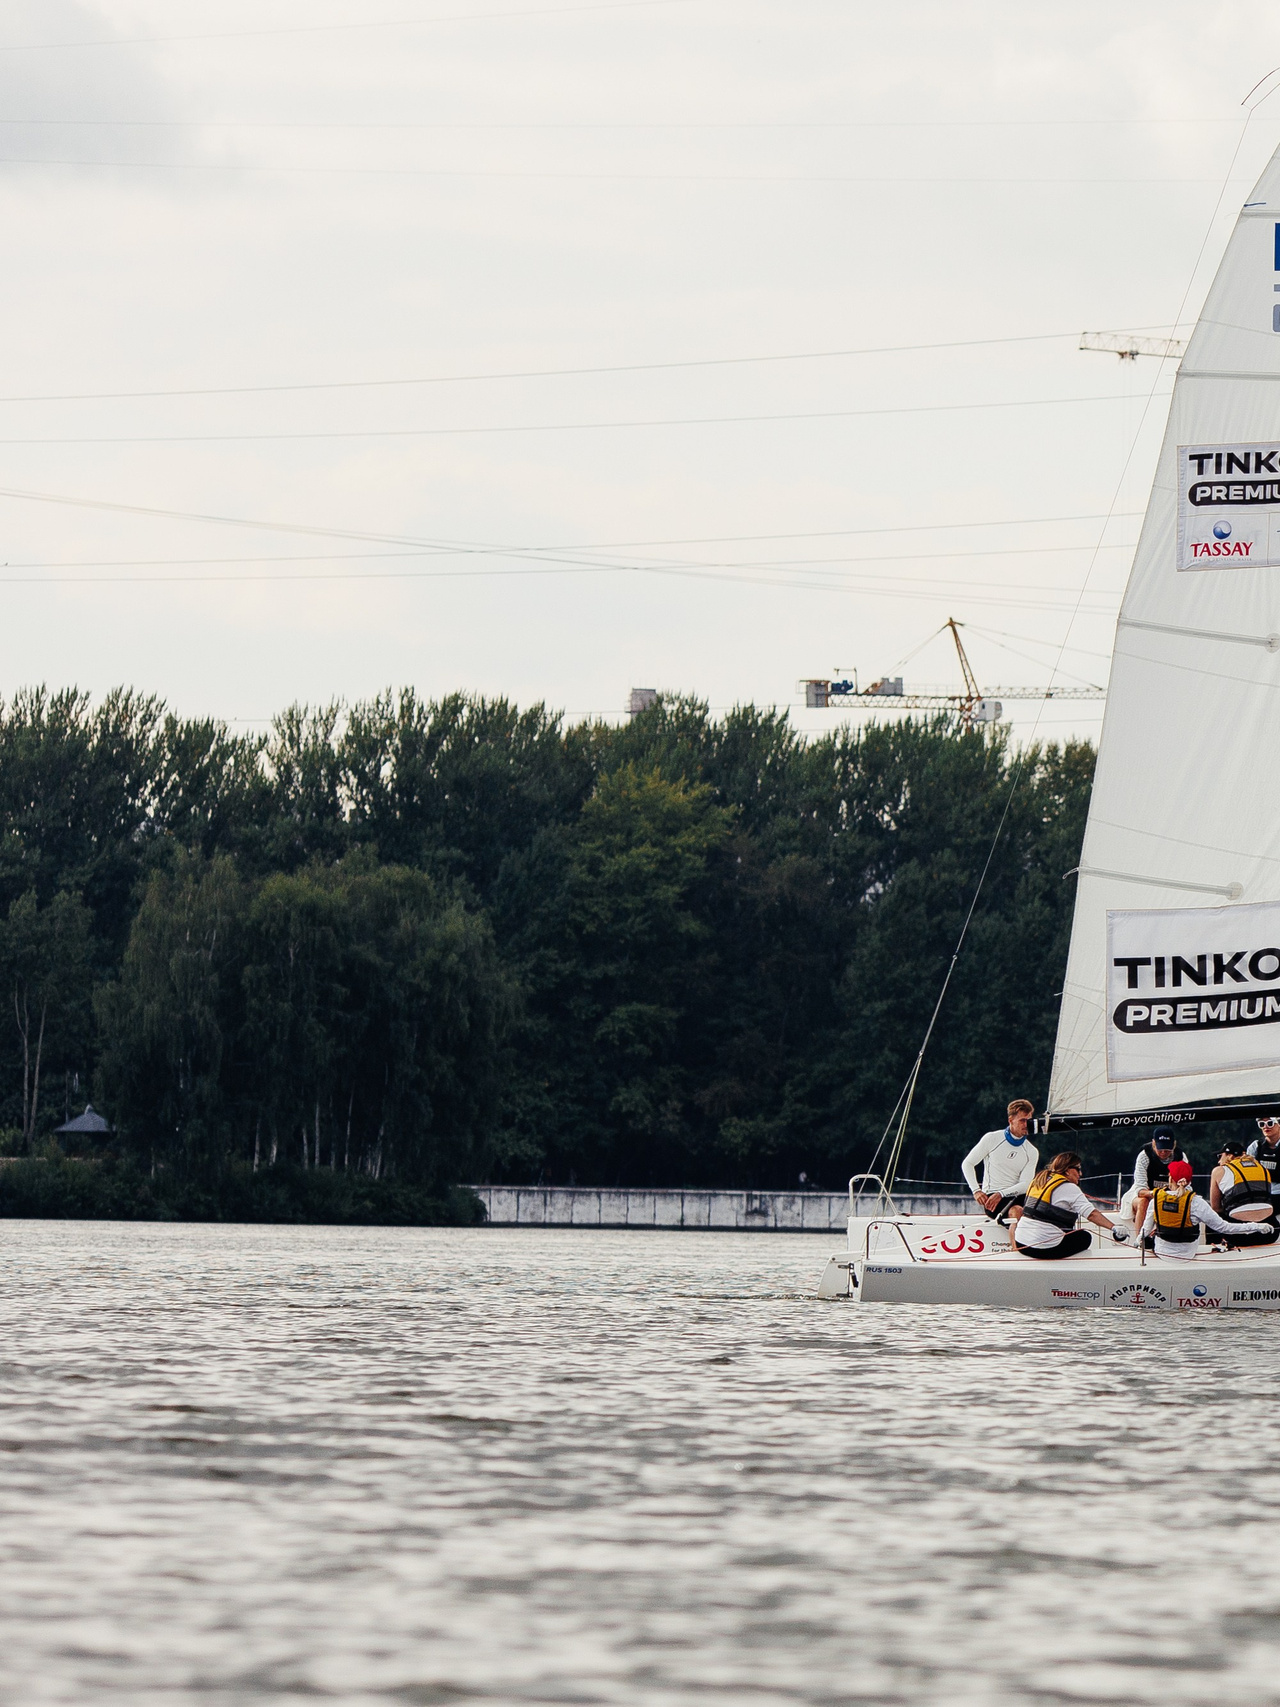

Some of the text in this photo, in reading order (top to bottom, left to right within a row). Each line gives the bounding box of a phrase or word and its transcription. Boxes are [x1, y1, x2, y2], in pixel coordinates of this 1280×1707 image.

[1189, 541, 1253, 557] TASSAY
[1110, 1112, 1196, 1128] pro-yachting.ru
[1110, 1284, 1167, 1303] МОРПРИБОР
[1176, 1297, 1223, 1308] TASSAY
